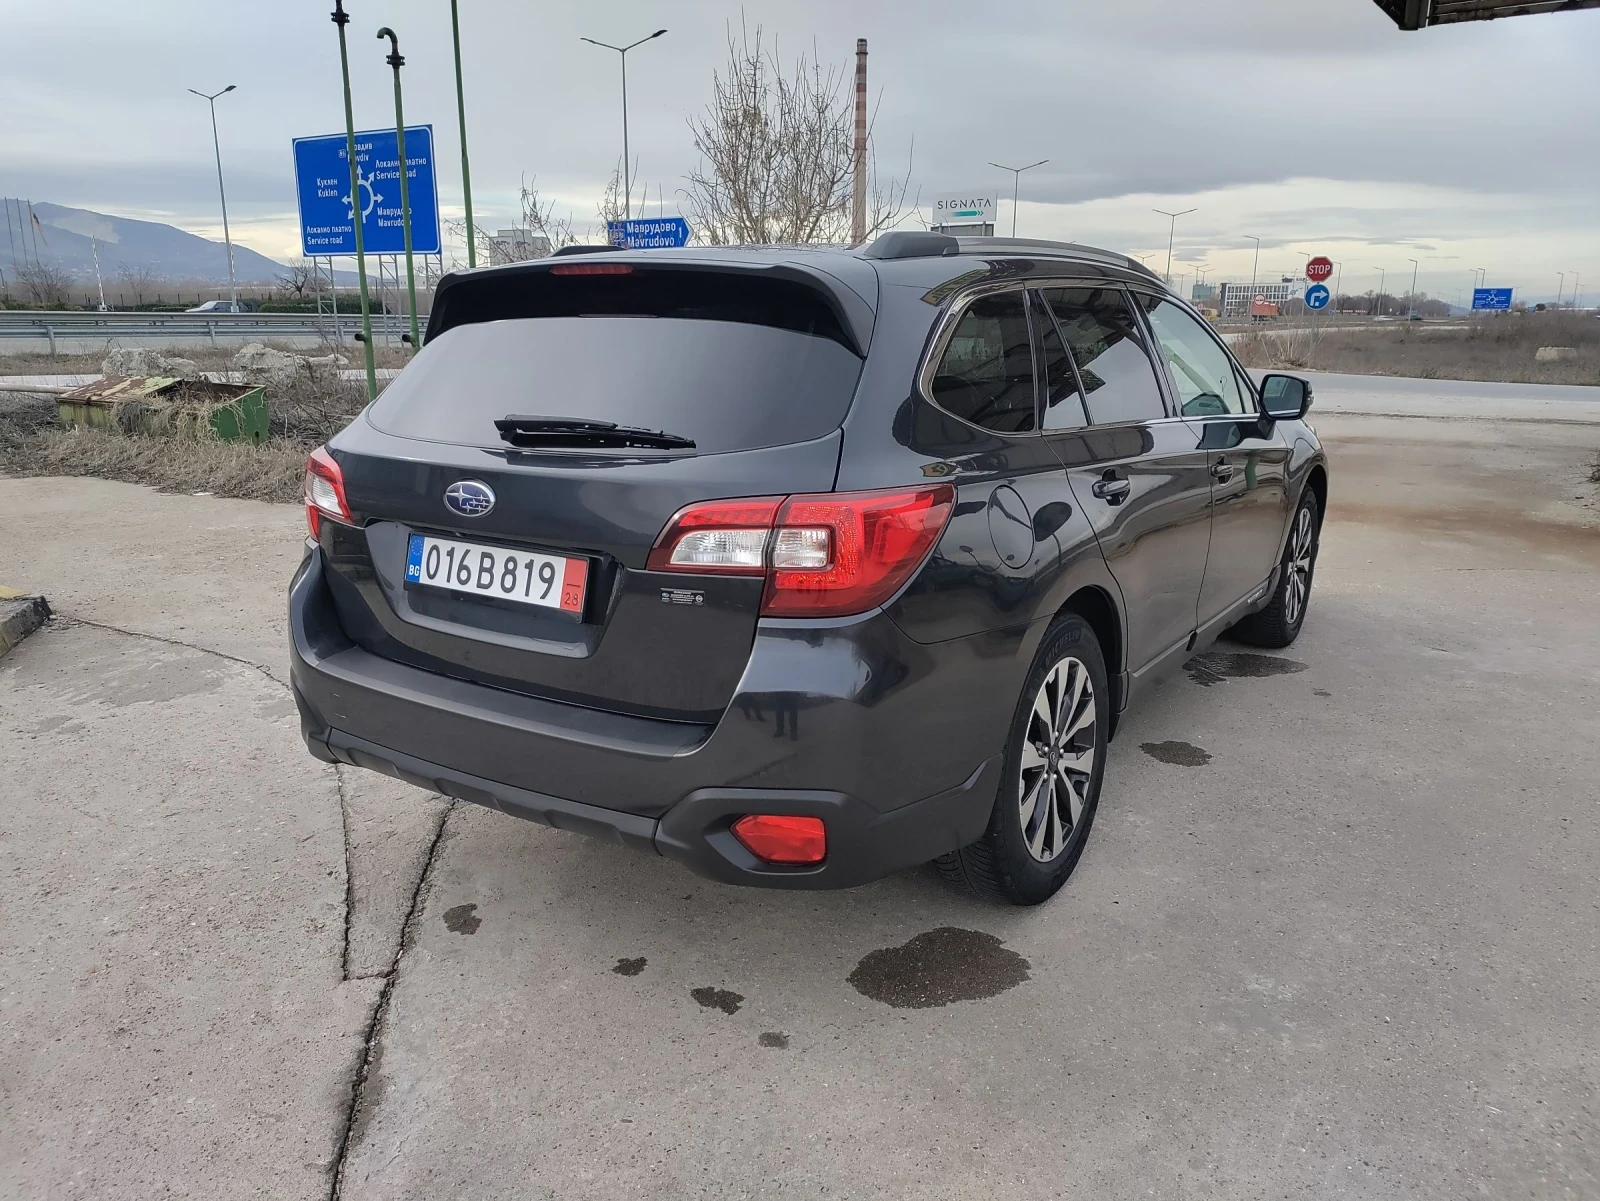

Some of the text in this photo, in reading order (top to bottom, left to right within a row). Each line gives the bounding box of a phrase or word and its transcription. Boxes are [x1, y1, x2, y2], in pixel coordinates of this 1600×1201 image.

[376, 168, 417, 180] Service oad
[316, 178, 338, 188] Куклен
[317, 189, 338, 198] Kuklen
[937, 198, 992, 210] SIGNATA
[306, 225, 352, 234] Локално платно
[626, 222, 676, 235] Маврудово
[307, 235, 343, 245] Service road
[627, 235, 675, 248] Mavrudovo
[1308, 264, 1331, 275] STOP
[408, 564, 420, 576] BG
[426, 544, 556, 600] 016B819
[564, 591, 580, 606] 28
